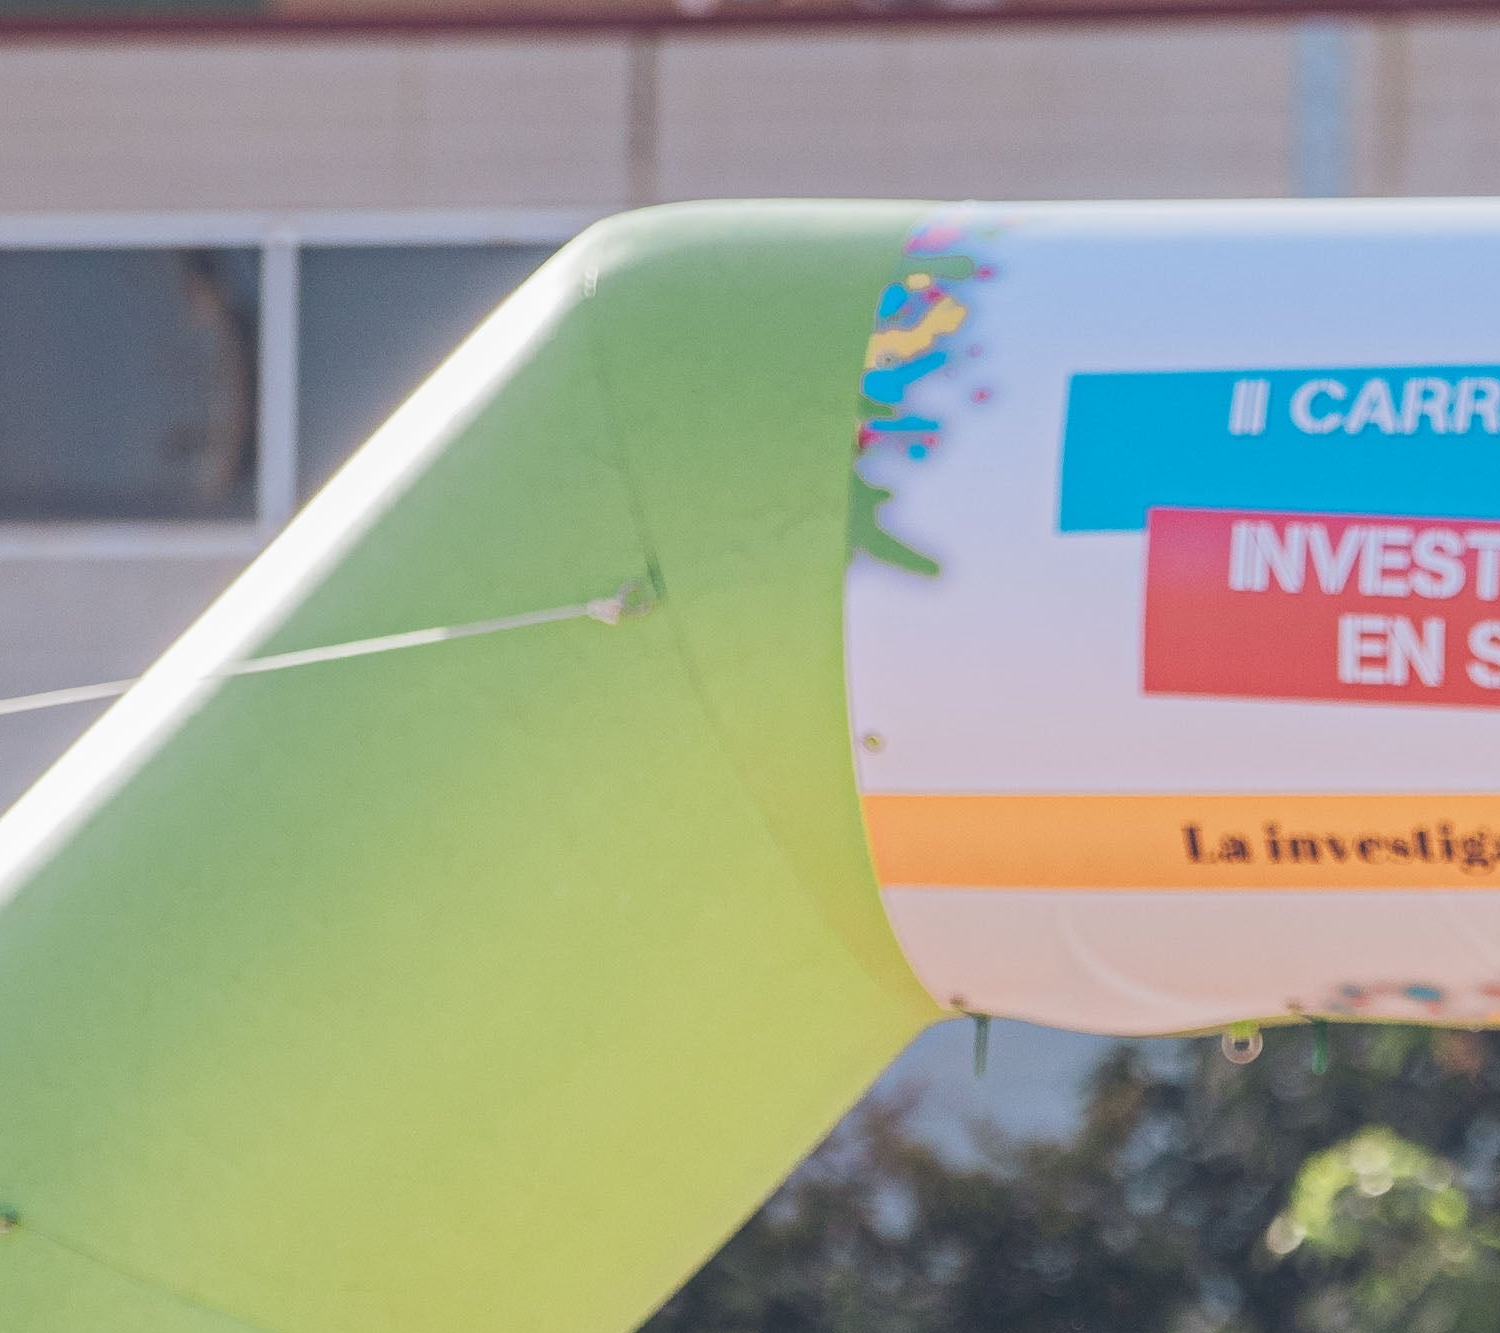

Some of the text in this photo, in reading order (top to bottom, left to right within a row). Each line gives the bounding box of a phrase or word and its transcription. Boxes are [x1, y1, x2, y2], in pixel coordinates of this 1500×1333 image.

[1229, 378, 1269, 435] II
[1338, 612, 1446, 688] EN
[1180, 822, 1253, 864] La
